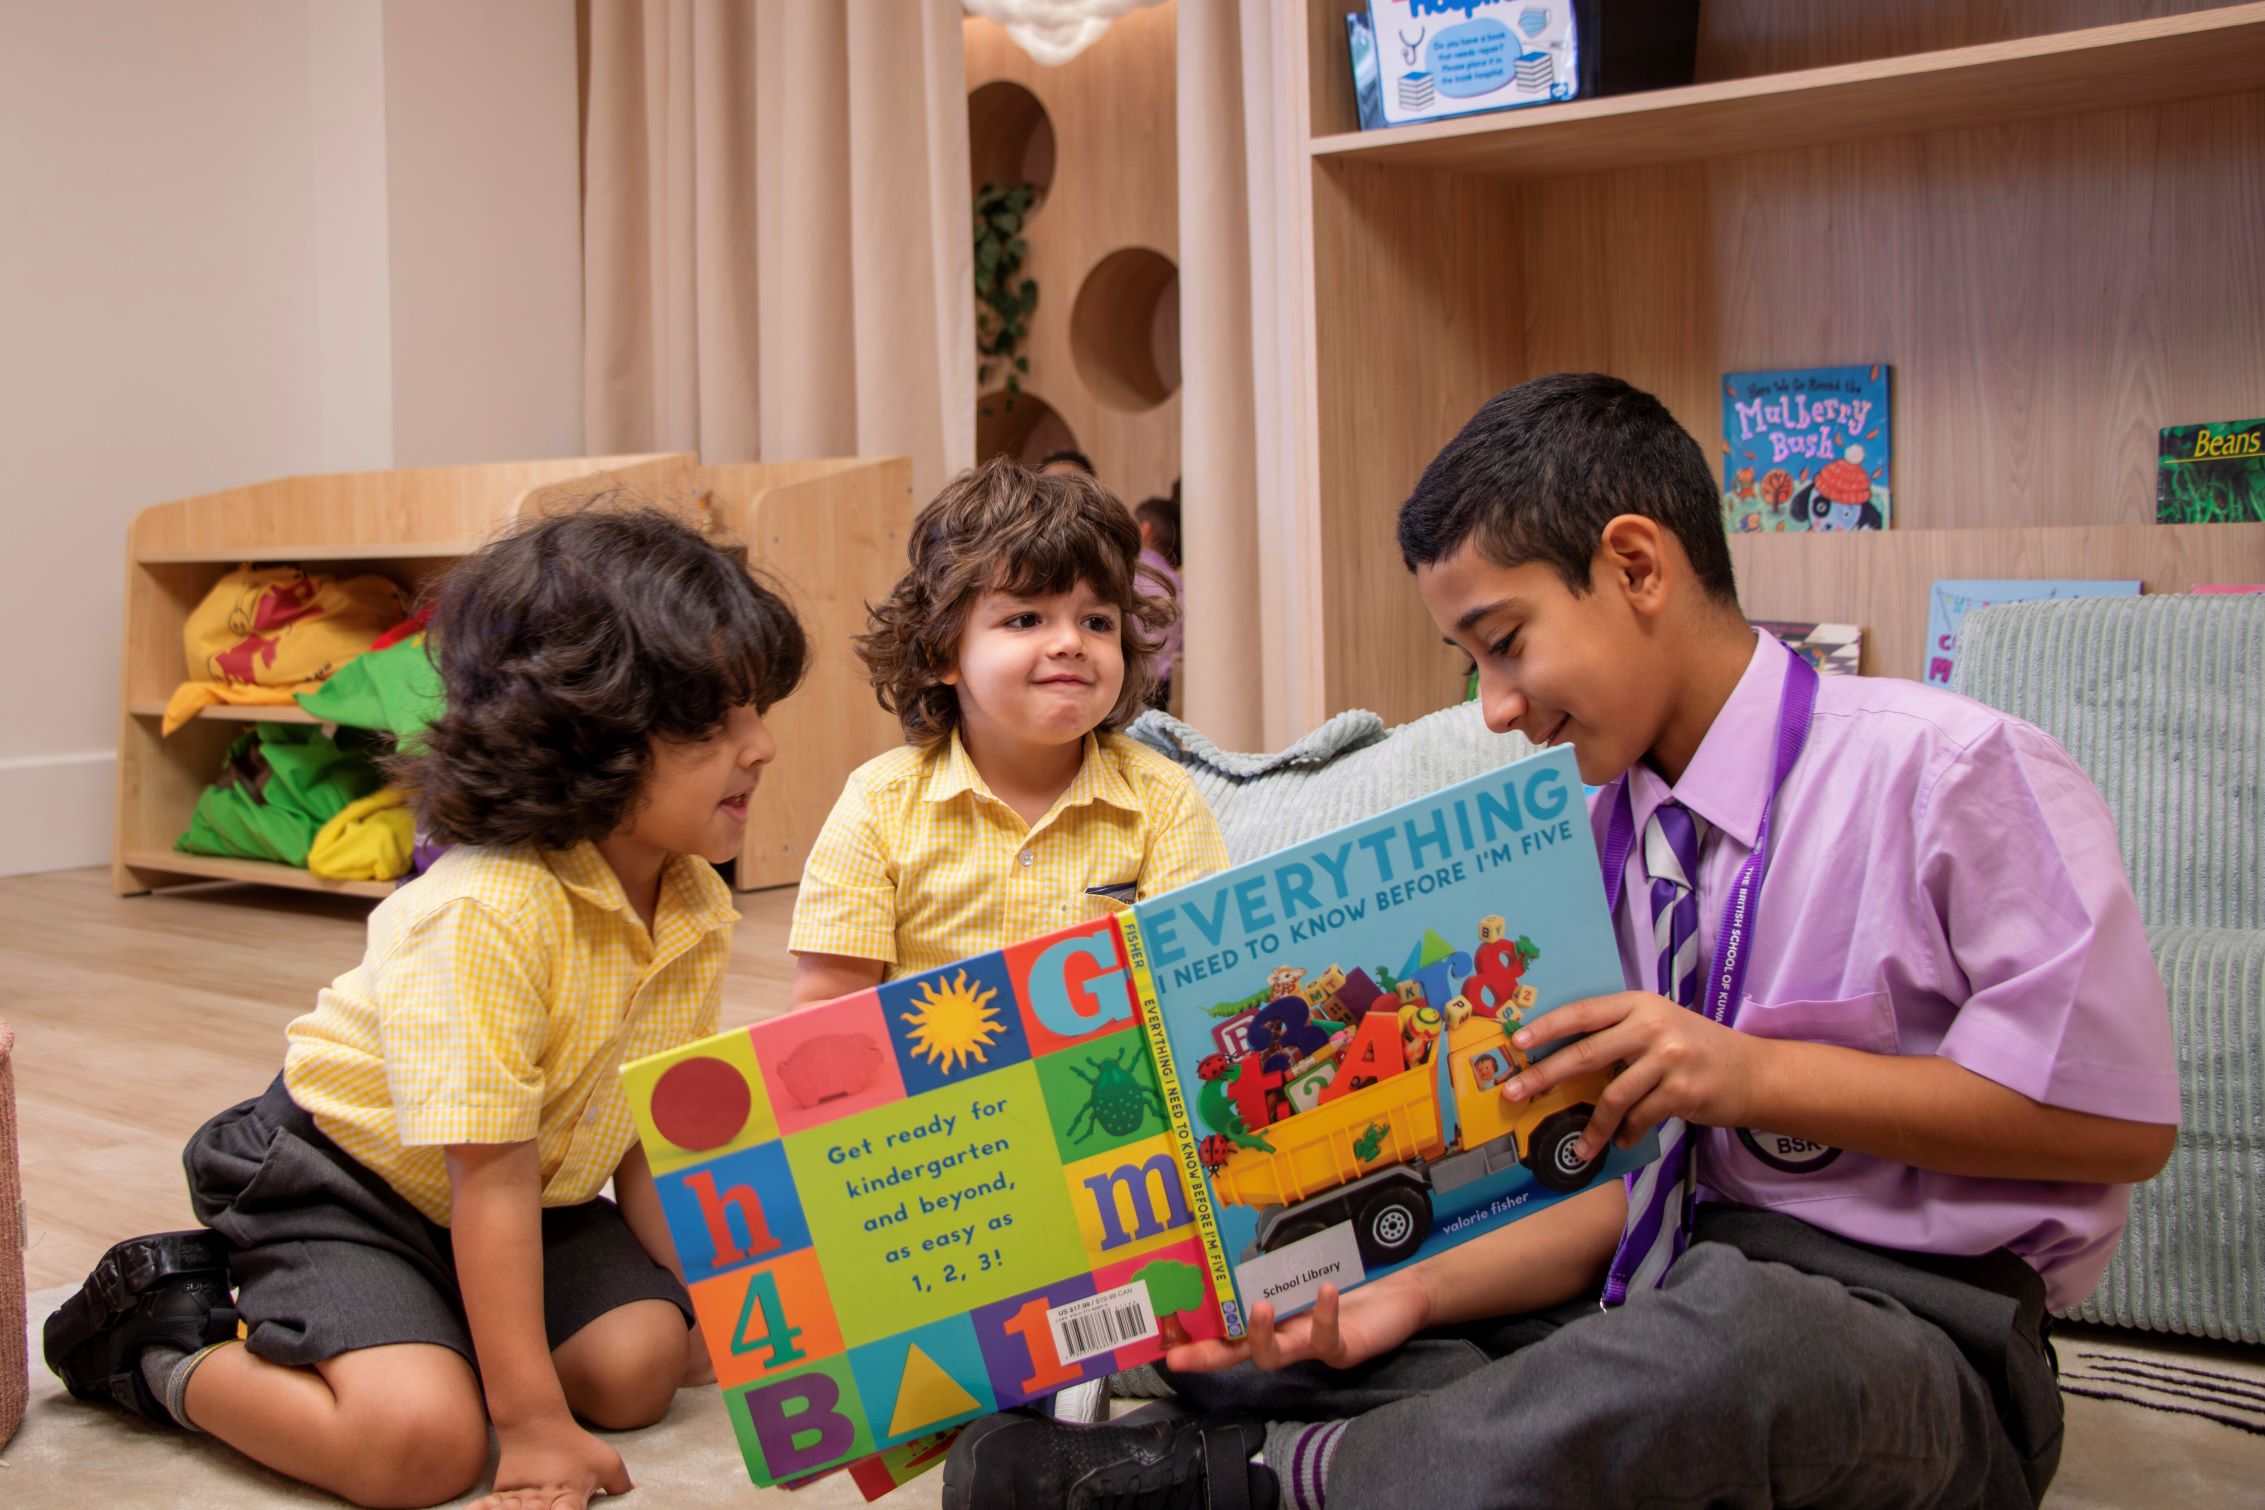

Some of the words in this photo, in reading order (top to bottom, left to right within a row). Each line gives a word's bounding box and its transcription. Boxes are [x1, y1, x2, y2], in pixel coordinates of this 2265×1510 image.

[1735, 394, 1872, 440] Mulberry
[1769, 425, 1834, 463] Bush
[2193, 428, 2261, 457] Beans
[1143, 768, 1568, 968] EVERYTHING
[1741, 866, 1754, 886] THE
[1157, 974, 1167, 994] I
[1173, 950, 1239, 988] NEED
[1245, 933, 1280, 960] TO
[1289, 898, 1365, 944] KNOW
[1375, 861, 1466, 911] BEFORE
[1475, 843, 1512, 873] I'M
[1520, 820, 1573, 855] FIVE
[1733, 888, 1748, 928] BRITISH
[1124, 923, 1145, 969] FISHER
[1724, 929, 1741, 974] SCHOOL
[1028, 928, 1134, 1037] G
[1721, 974, 1732, 990] OF
[1144, 998, 1173, 1077] EVERYTHING
[1317, 1011, 1405, 1107] A
[1167, 1086, 1184, 1119] NEED
[827, 1138, 874, 1165] Get
[886, 1113, 957, 1148] ready
[970, 1099, 1008, 1121] for
[1176, 1121, 1189, 1139] TO
[846, 1138, 1010, 1199] kindergarten
[1181, 1141, 1201, 1179] KNOW
[682, 1168, 782, 1269] h
[863, 1202, 909, 1232] and
[918, 1171, 1016, 1215] beyond,
[1083, 1153, 1197, 1252] m
[1191, 1183, 1212, 1229] BEFORE
[1442, 1209, 1488, 1235] valorie
[1490, 1192, 1529, 1215] fisher
[885, 1246, 911, 1264] as
[921, 1225, 975, 1251] easy
[987, 1213, 1014, 1231] as
[1204, 1231, 1218, 1251] I'M
[910, 1274, 932, 1293] 1,
[942, 1264, 967, 1283] 2,
[977, 1249, 1003, 1272] 3!
[1210, 1253, 1227, 1282] FIVE
[1263, 1275, 1300, 1299] School
[1302, 1260, 1341, 1283] Library
[730, 1268, 807, 1370] 4
[1058, 1309, 1069, 1317] US
[1069, 1301, 1091, 1313] $17.99
[1117, 1287, 1133, 1297] CAN
[743, 1371, 856, 1480] B
